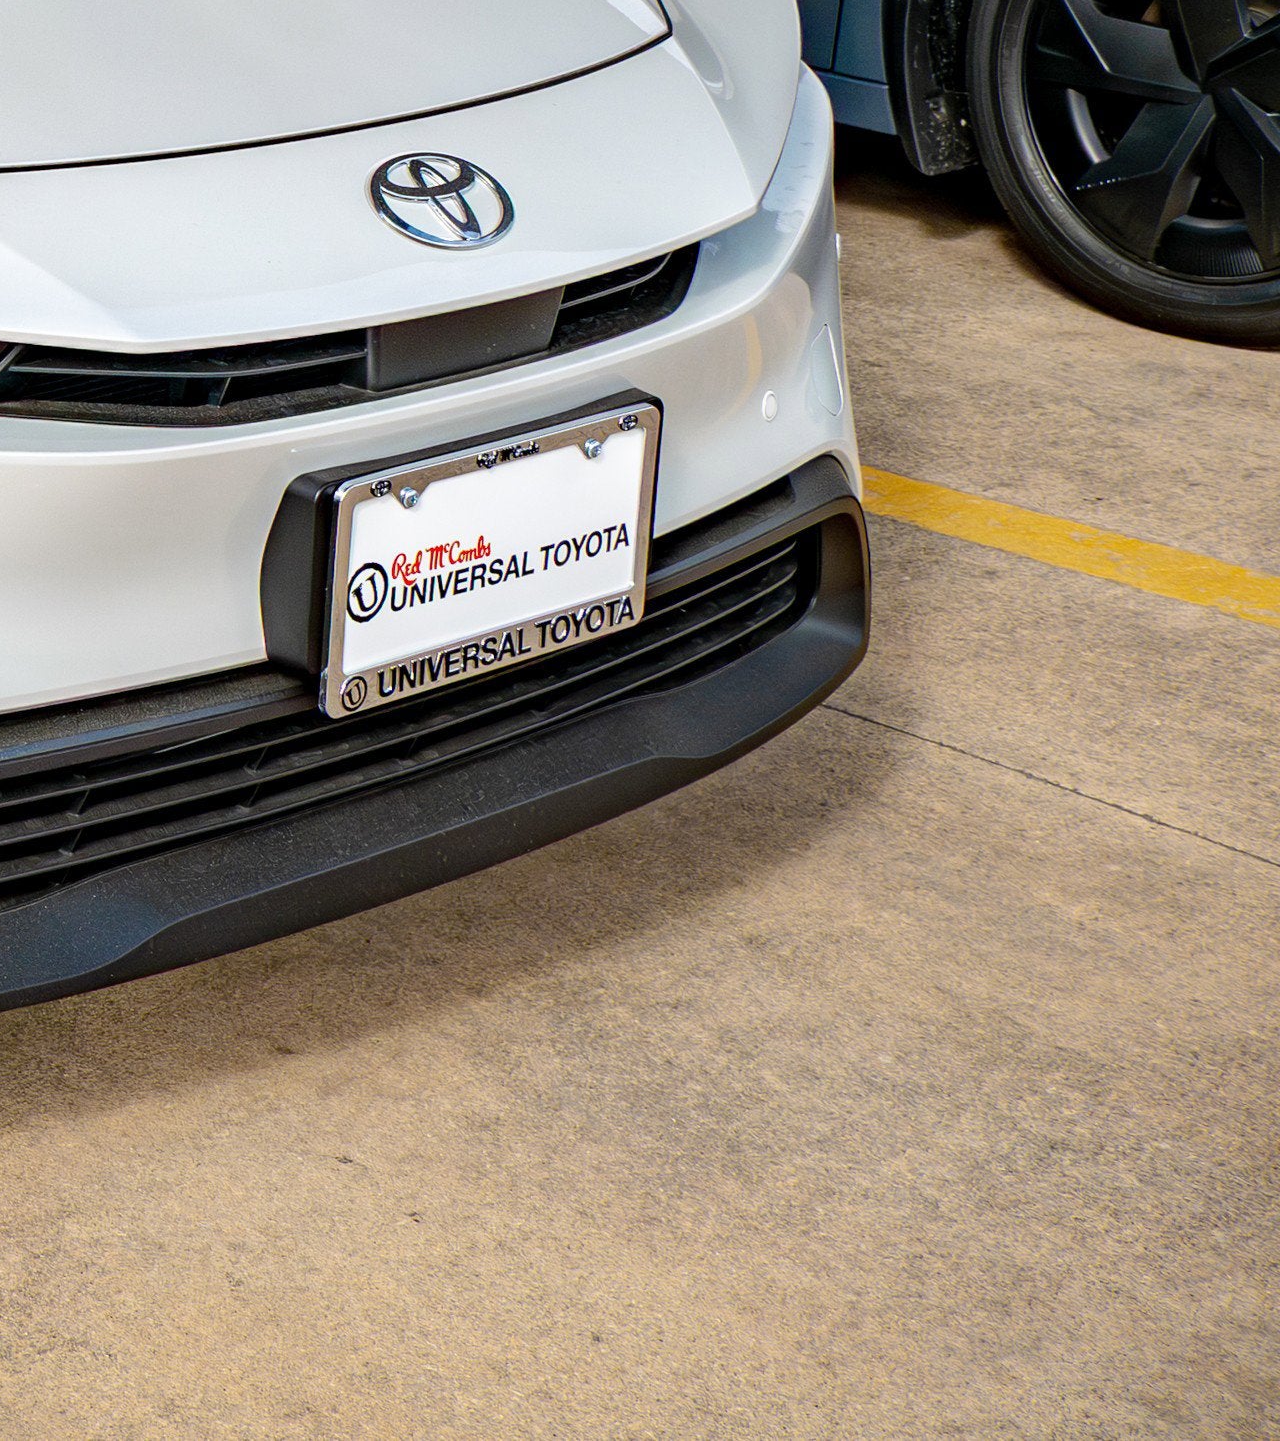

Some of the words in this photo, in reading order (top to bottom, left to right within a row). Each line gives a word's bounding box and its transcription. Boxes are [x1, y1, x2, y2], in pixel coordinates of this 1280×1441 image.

[390, 551, 535, 612] UNIVERSAL
[540, 523, 630, 571] TOYOTA
[391, 550, 423, 586] Red
[425, 535, 491, 570] McCombs
[377, 627, 532, 698] UNIVERSAL
[534, 595, 635, 649] TOYOTA
